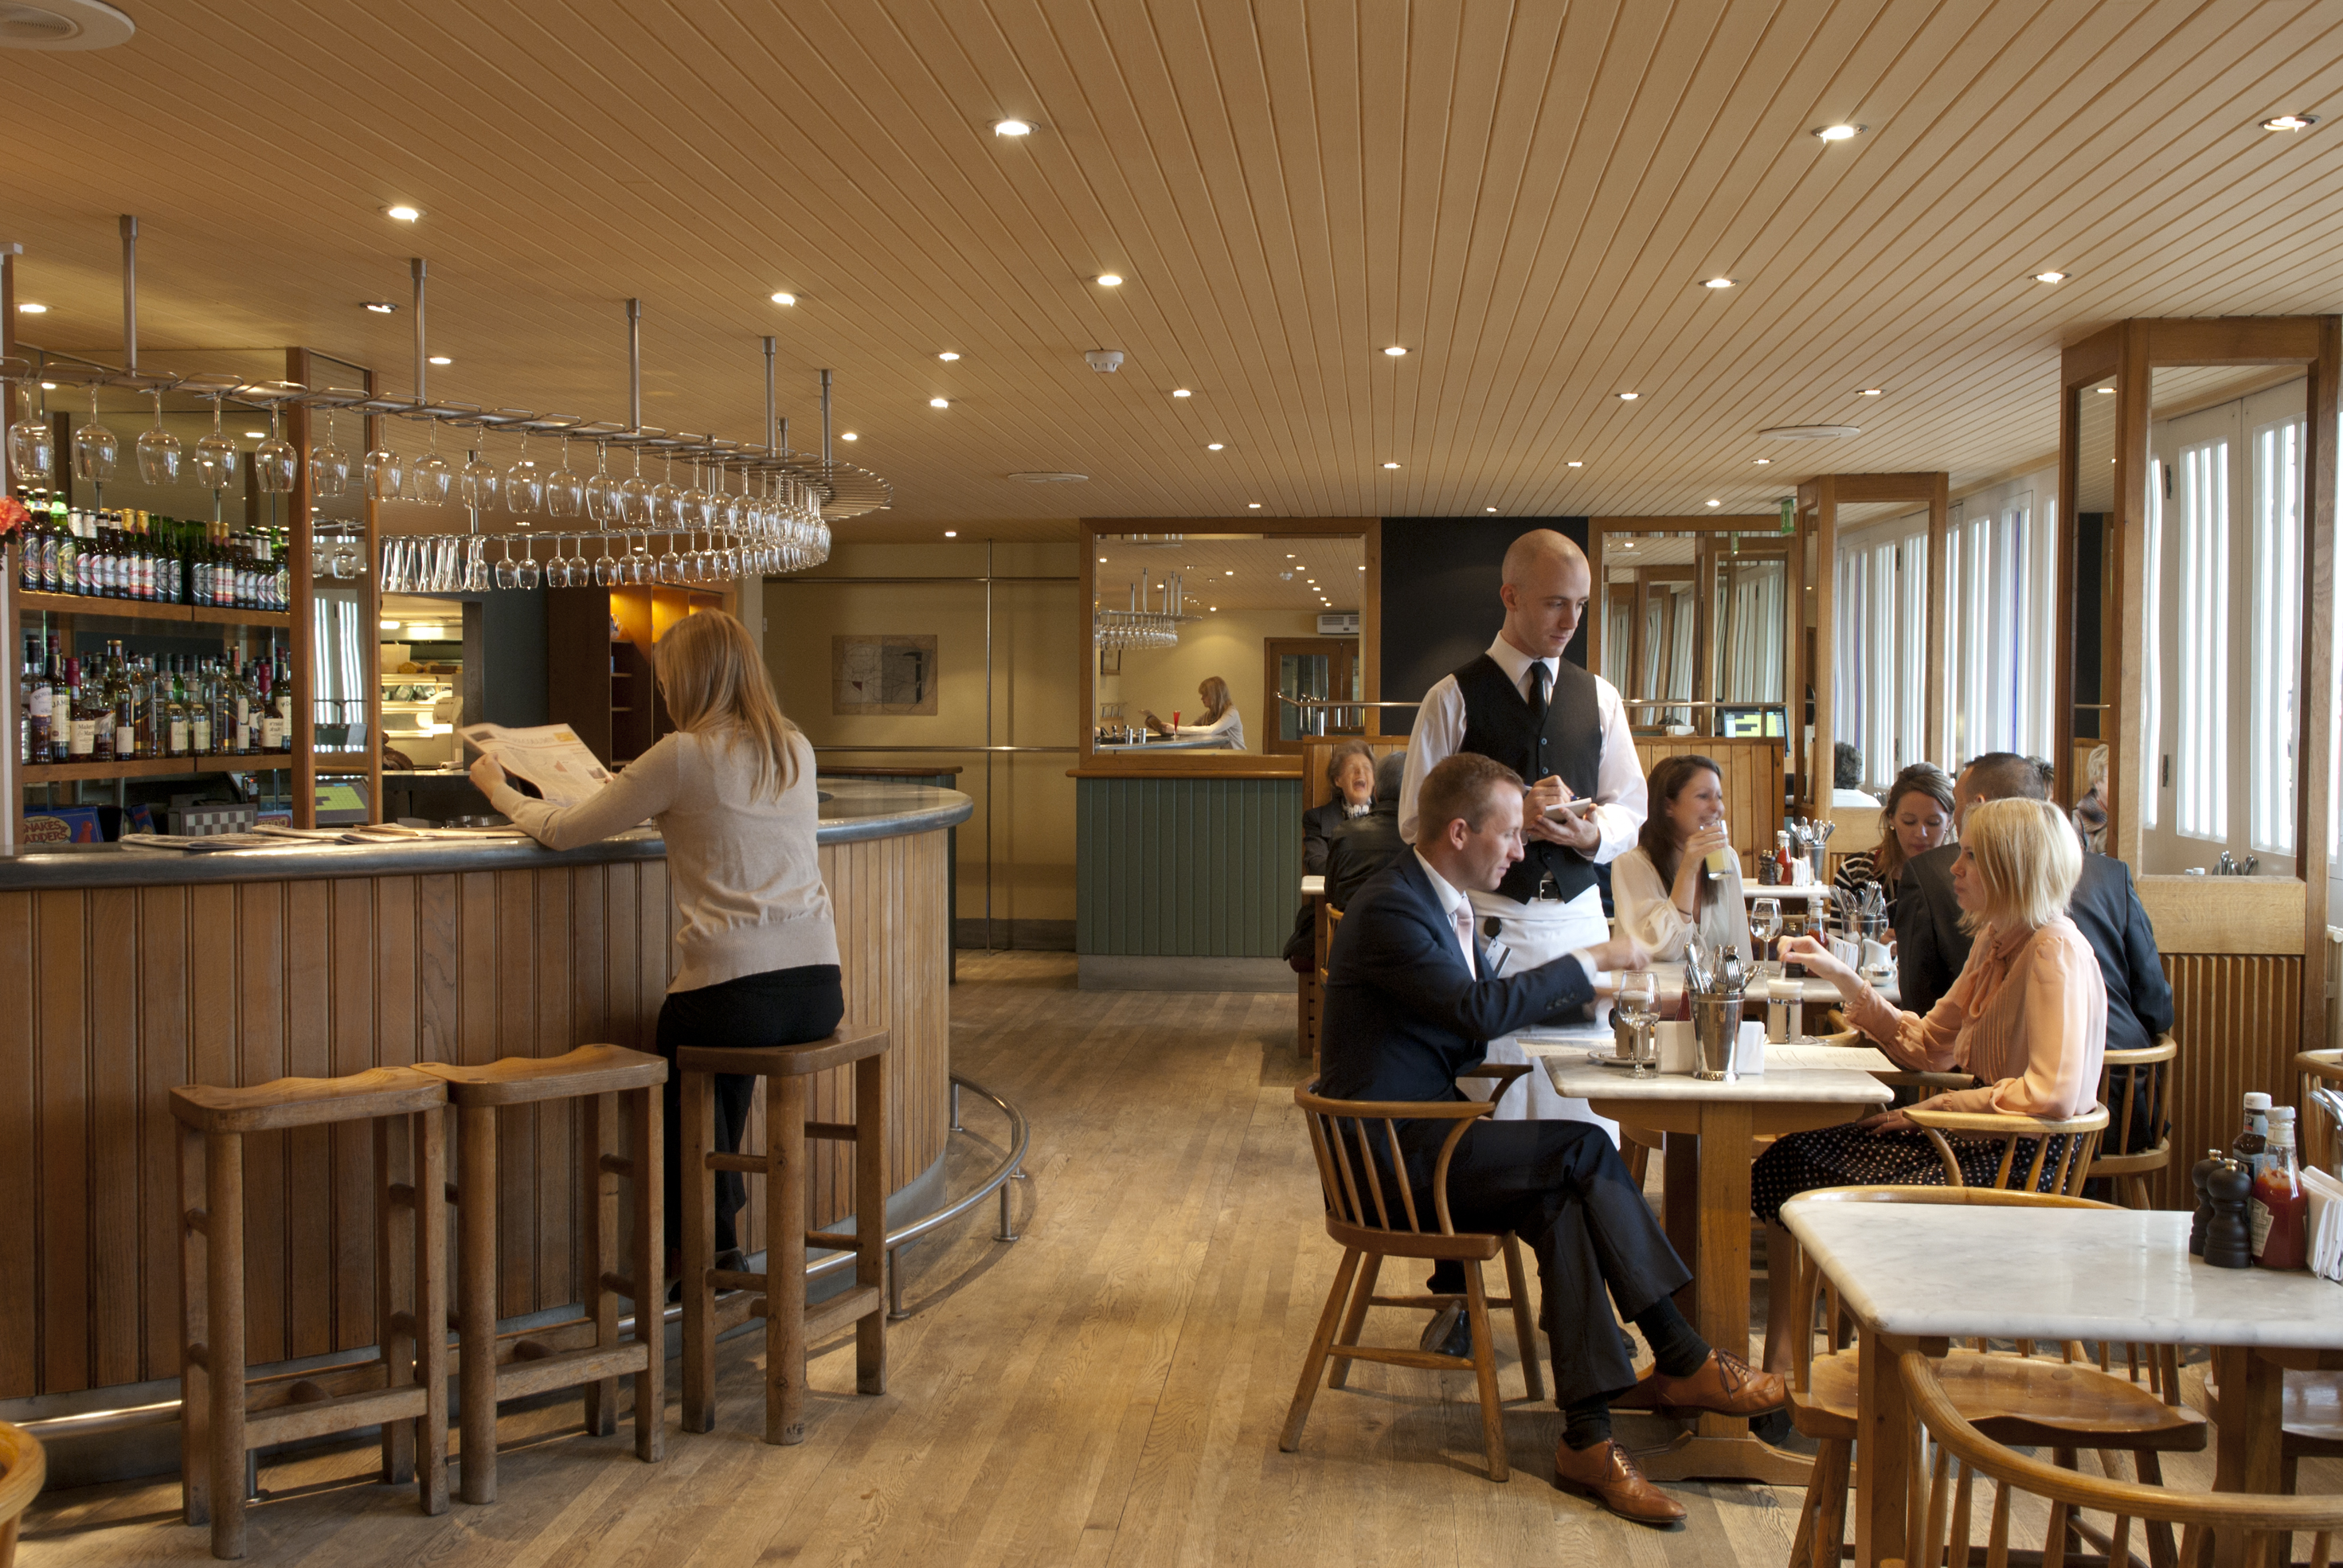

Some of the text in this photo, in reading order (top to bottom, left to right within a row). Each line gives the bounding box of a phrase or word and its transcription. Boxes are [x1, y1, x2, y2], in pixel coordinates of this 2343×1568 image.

[52, 699, 69, 708] JAME
[24, 820, 61, 833] NAKES
[24, 831, 68, 844] ADDERS
